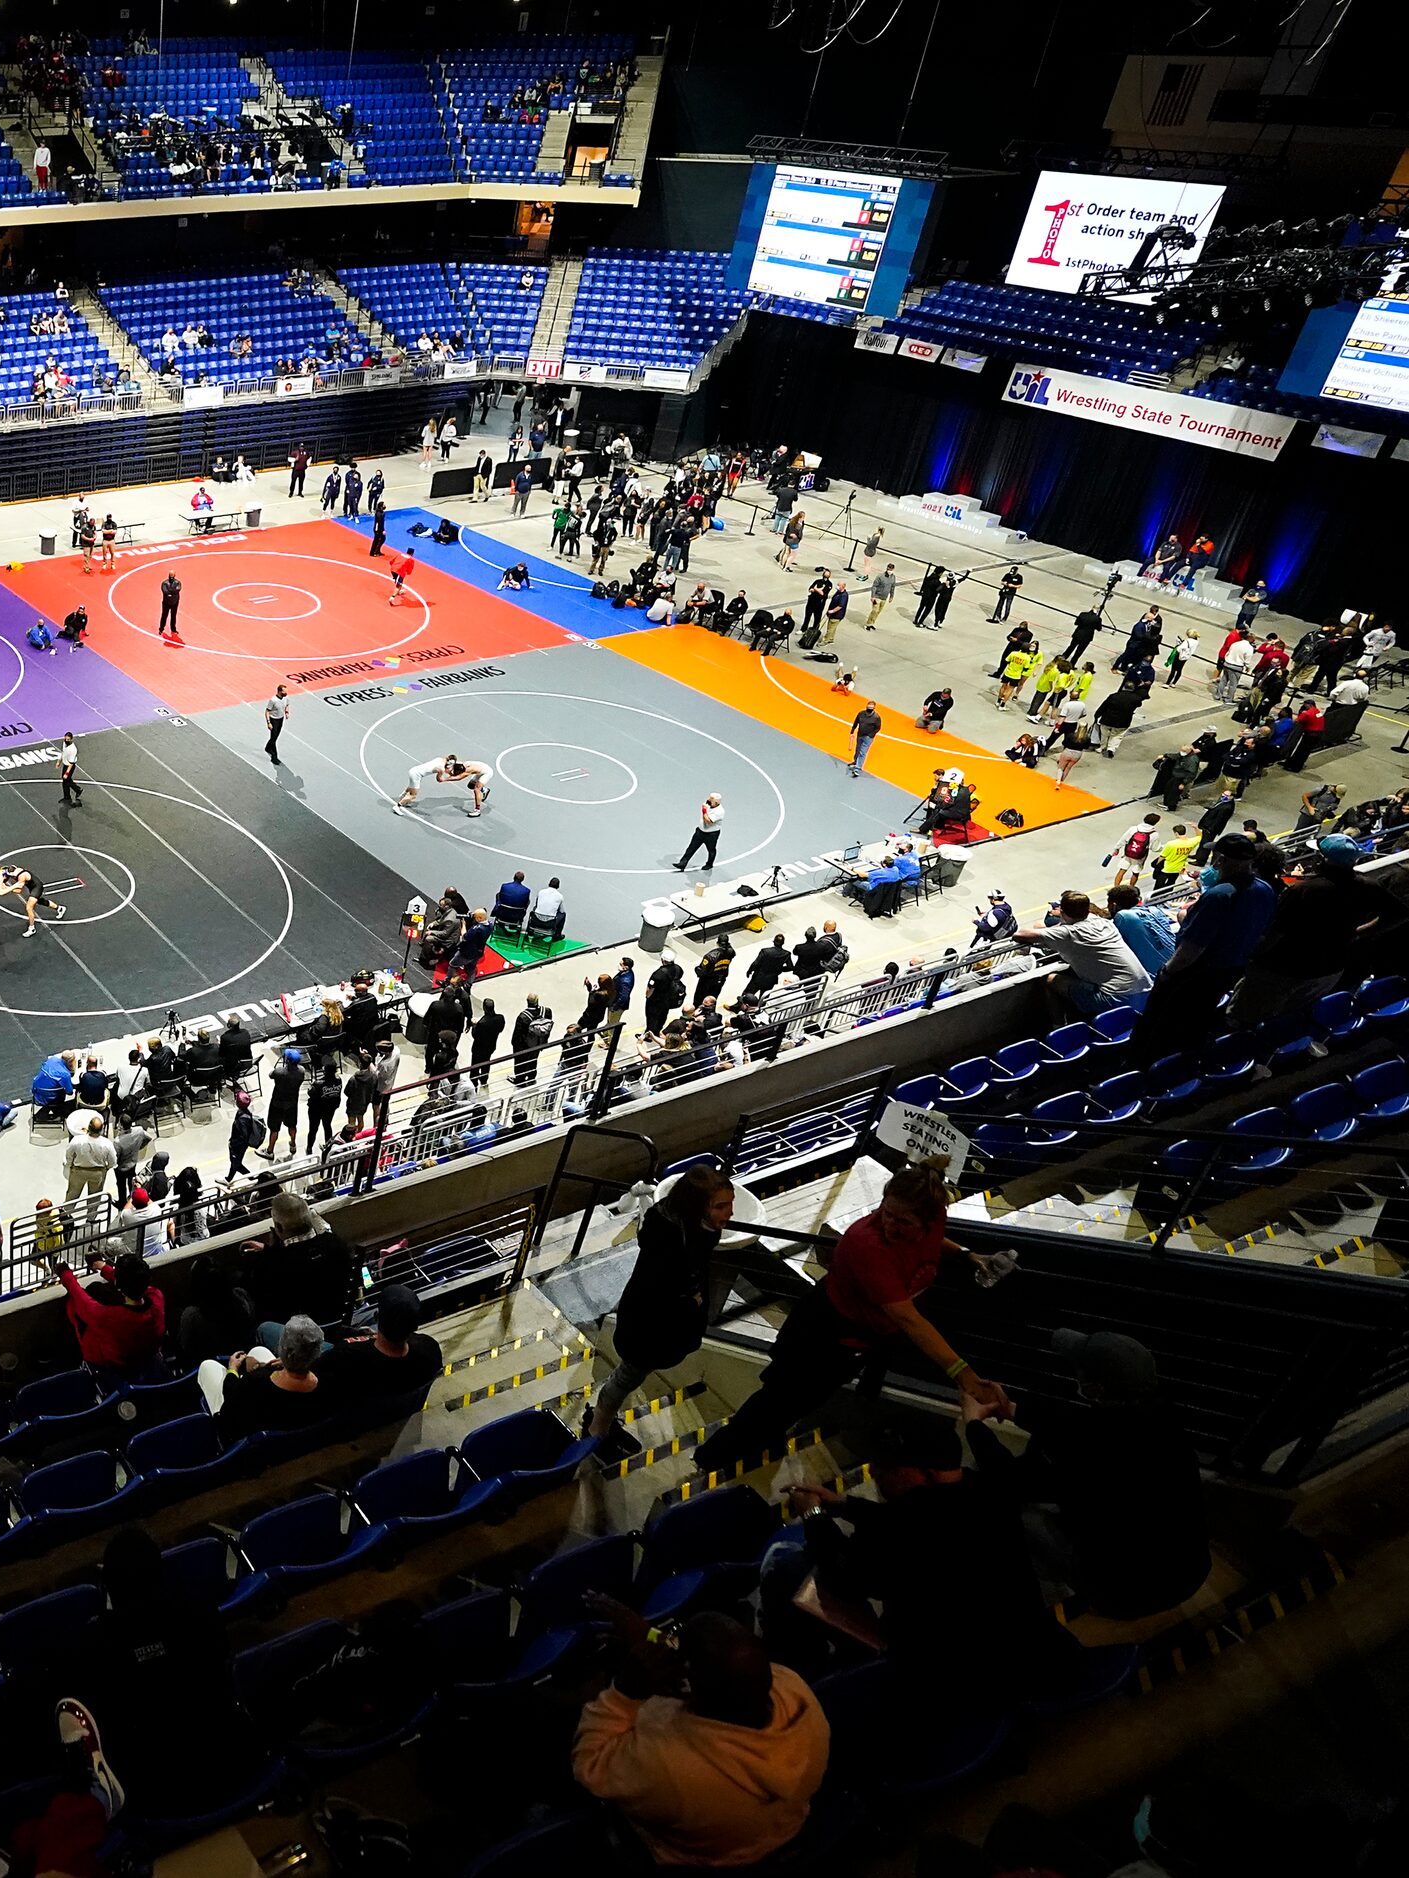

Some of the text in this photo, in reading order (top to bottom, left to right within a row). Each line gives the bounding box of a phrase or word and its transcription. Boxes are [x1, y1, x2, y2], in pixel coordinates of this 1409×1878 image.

[1087, 203, 1126, 219] Order
[1129, 209, 1166, 223] team
[1169, 213, 1199, 226] and
[1042, 207, 1065, 259] PHOTO
[1081, 222, 1125, 239] action
[863, 333, 889, 348] balfour
[528, 361, 560, 377] EXIT
[1007, 370, 1283, 450] UIL Wrestling State Tournament
[921, 502, 963, 521] 2021 UIL
[398, 645, 465, 663] CYPRESS
[286, 661, 375, 684] FAIRBANKS
[323, 665, 506, 707] CYPRESS FAIRBANKS
[950, 772, 958, 781] 2
[413, 904, 421, 913] 3
[903, 1108, 958, 1145] WRESTLER
[901, 1122, 950, 1153] SEATING
